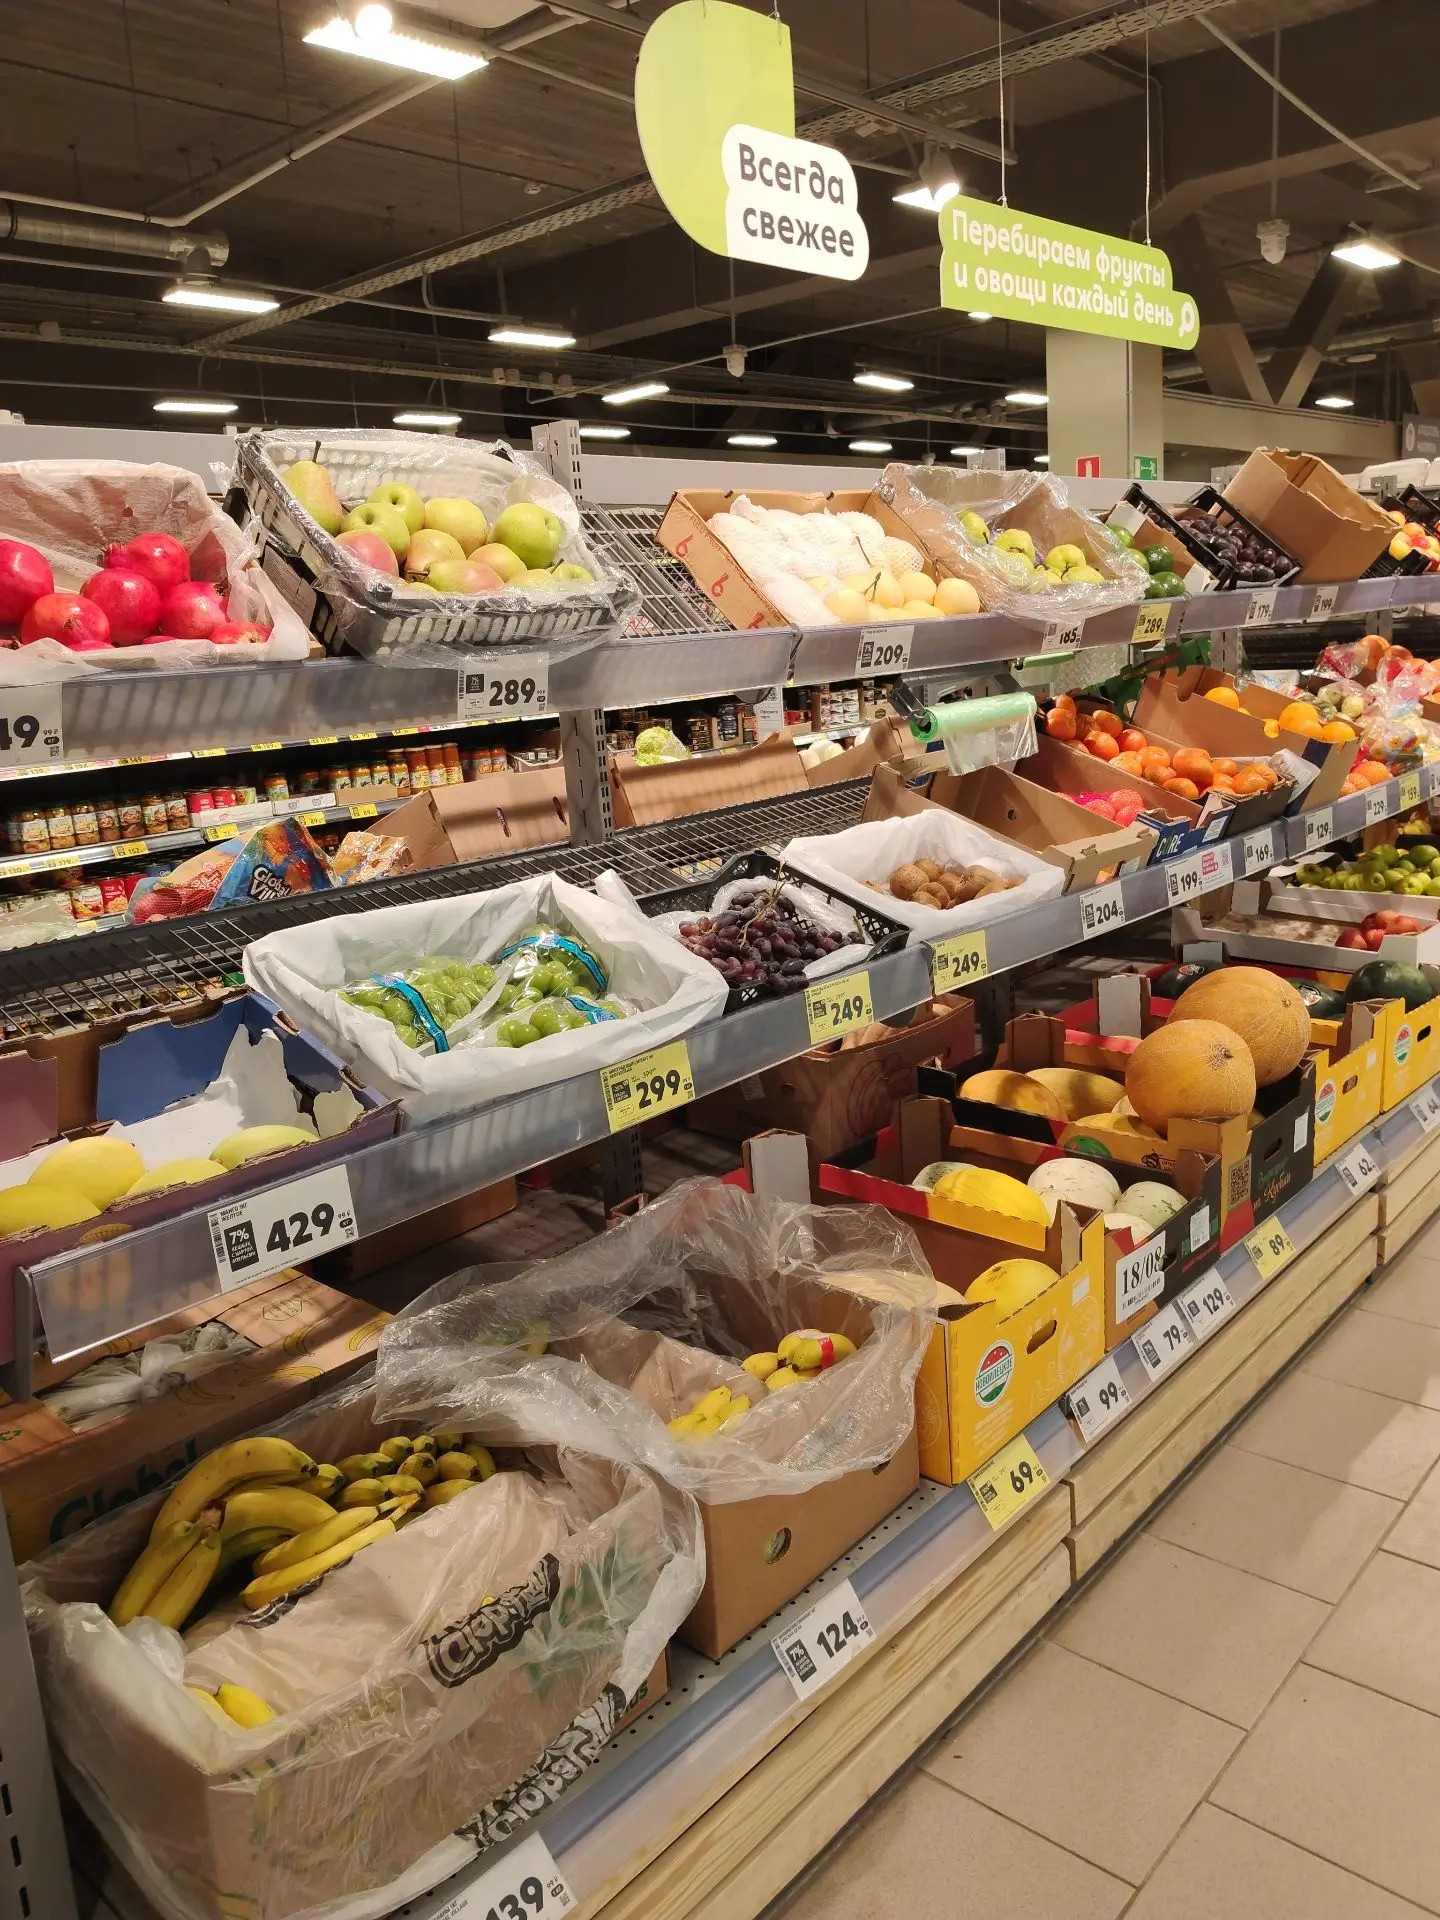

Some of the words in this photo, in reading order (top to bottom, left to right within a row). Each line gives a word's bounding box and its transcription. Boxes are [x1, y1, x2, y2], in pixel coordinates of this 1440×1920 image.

[738, 143, 845, 206] Всегда
[742, 206, 855, 258] свежее
[952, 209, 1091, 272] Перебираем
[1096, 244, 1167, 290] фрукты
[953, 264, 969, 289] и
[974, 274, 1047, 307] овощи
[1052, 279, 1129, 321] каждый
[1134, 291, 1174, 329] день
[1143, 617, 1163, 635] 289
[873, 643, 904, 667] 209
[488, 677, 536, 707] 289
[1316, 822, 1329, 840] 129
[1255, 843, 1269, 863] 169
[249, 877, 281, 901] Vill
[253, 865, 290, 896] Global
[1180, 870, 1198, 892] 199
[1096, 900, 1119, 925] 204
[952, 951, 980, 978] 249
[830, 995, 864, 1026] 249
[635, 1069, 681, 1110] 299
[1358, 1158, 1373, 1177] 62
[219, 1205, 240, 1217] МАНГО
[229, 1227, 250, 1245] 7%
[266, 1202, 335, 1253] 429
[1268, 1234, 1285, 1256] 89
[1121, 1245, 1164, 1297] 18/08
[1202, 1287, 1225, 1316] 129
[1163, 1324, 1182, 1352] 79
[1098, 1381, 1119, 1411] 99
[1010, 1461, 1034, 1494] 69
[816, 1610, 860, 1659] 124
[789, 1644, 805, 1662] 7%
